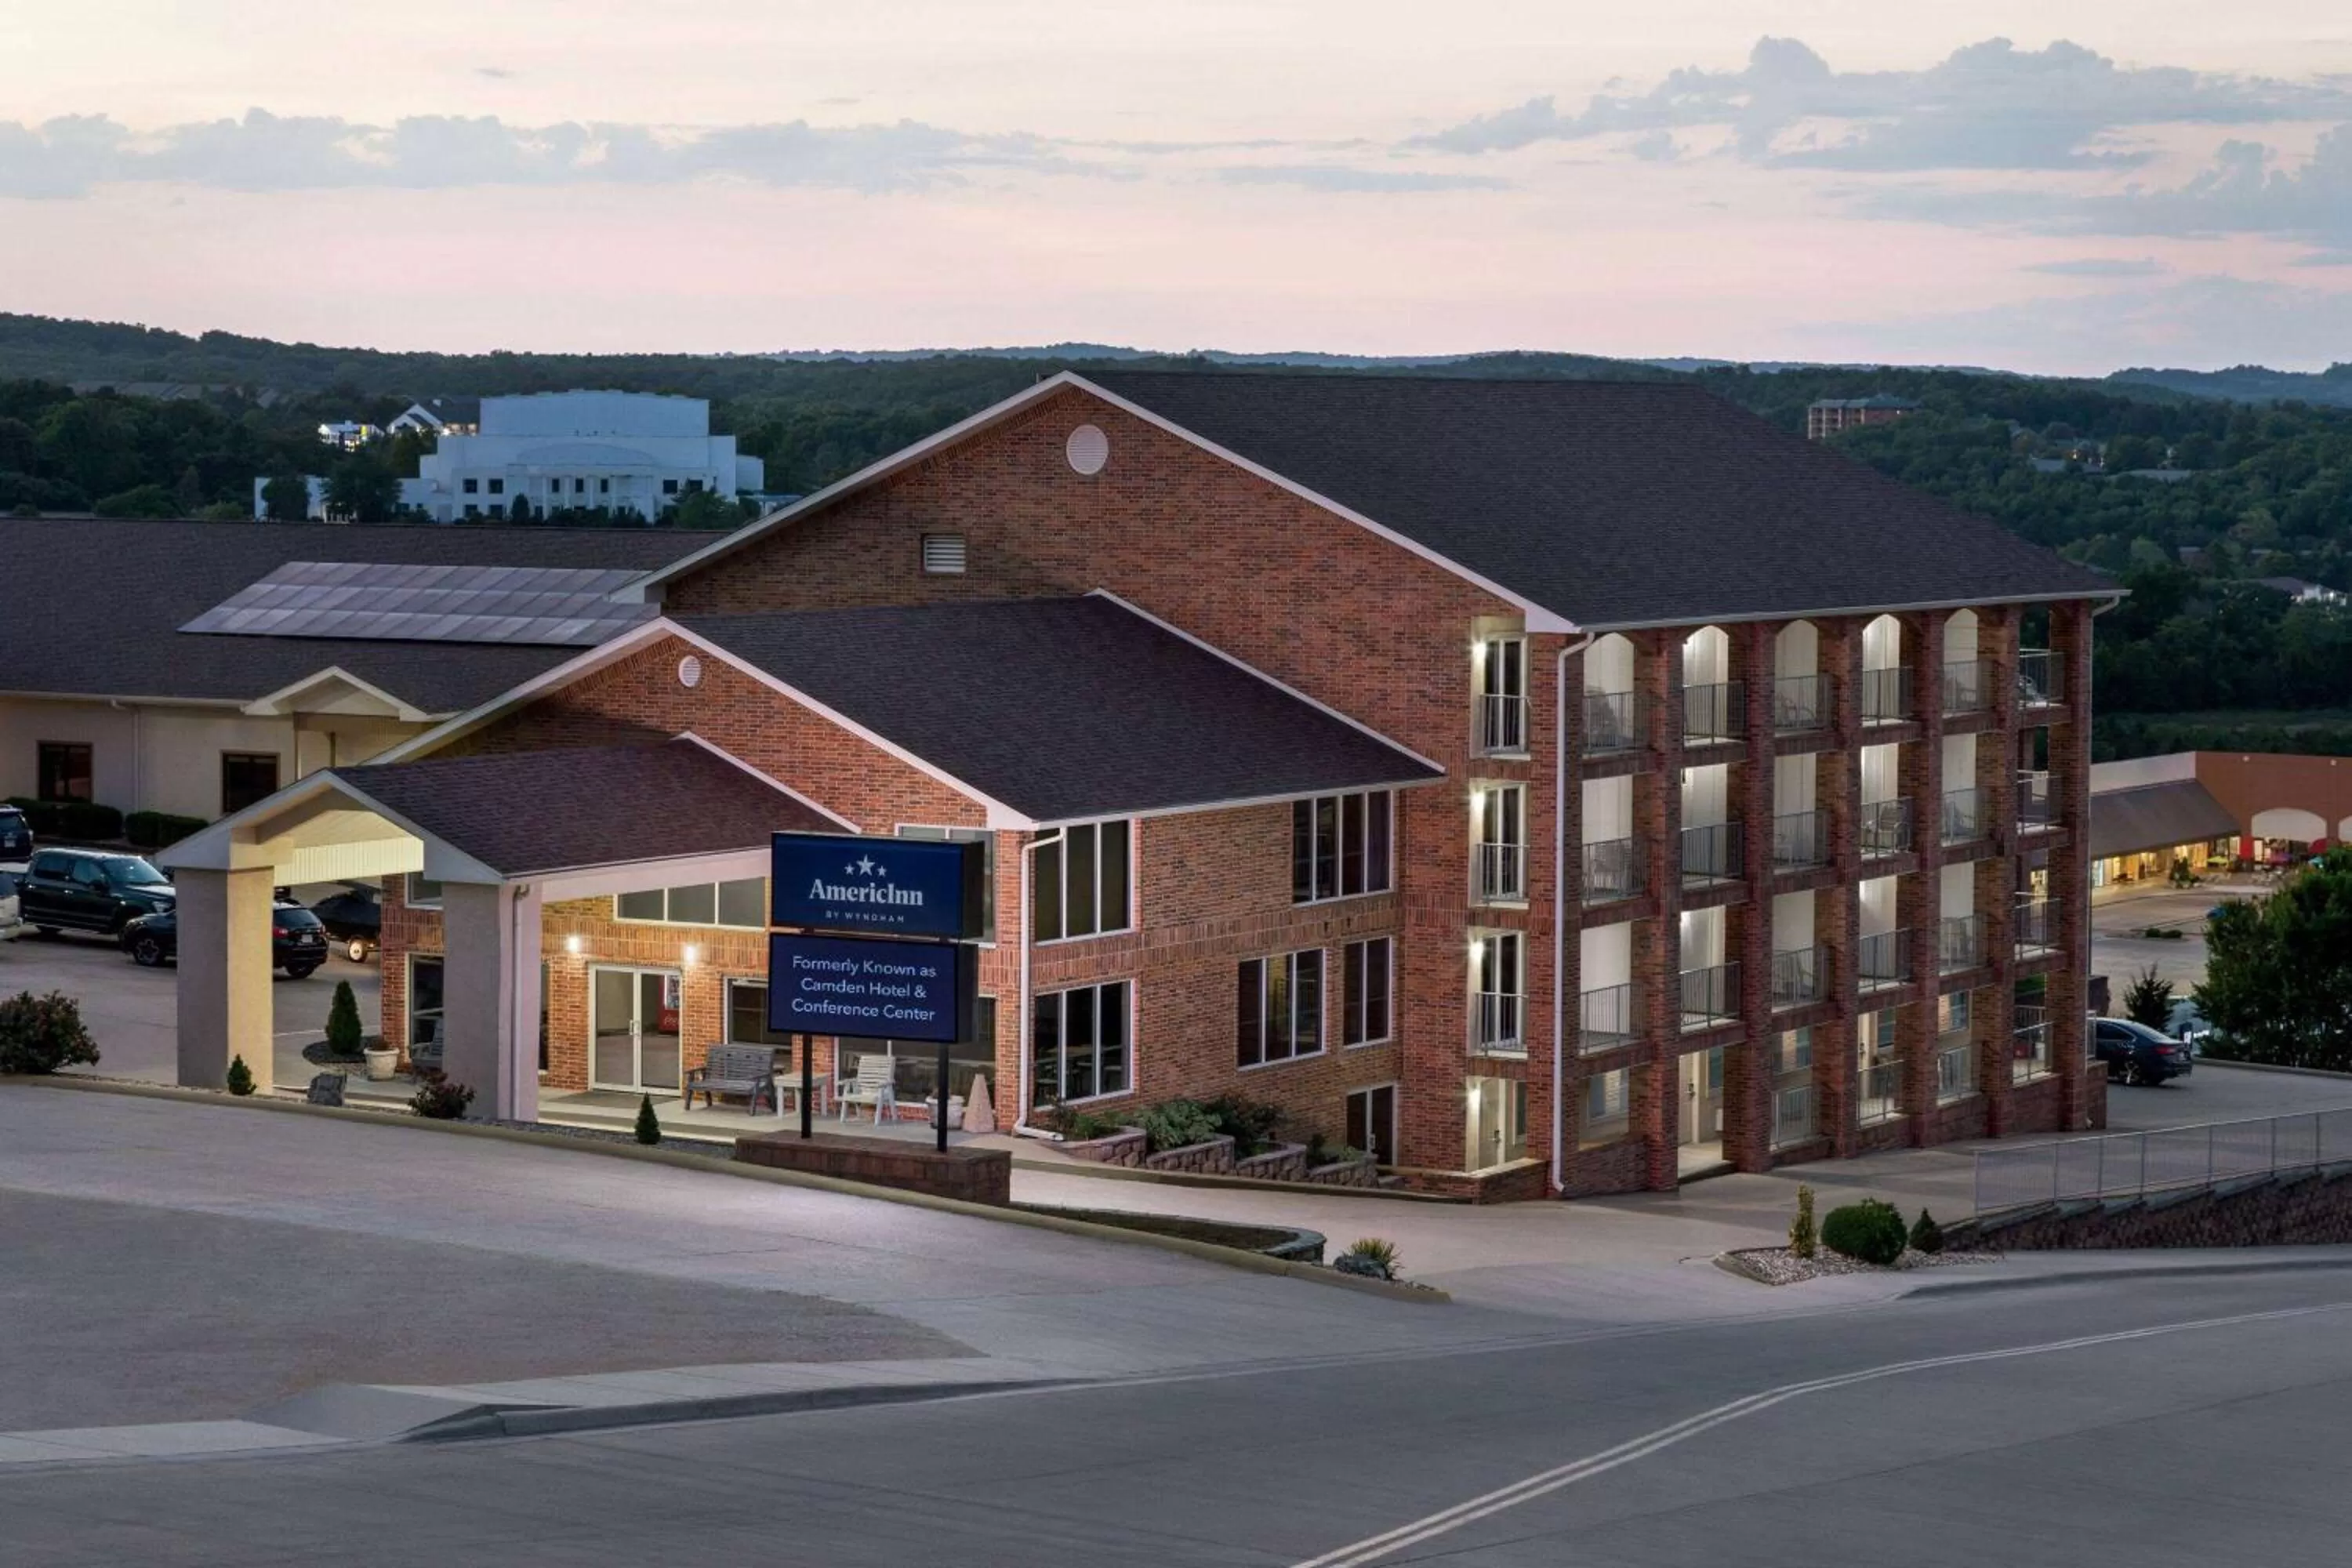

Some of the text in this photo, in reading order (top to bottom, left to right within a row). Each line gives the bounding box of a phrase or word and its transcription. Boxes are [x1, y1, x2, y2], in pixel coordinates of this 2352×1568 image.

[809, 878, 924, 906] AmericInn
[826, 910, 839, 919] BY
[793, 956, 937, 978] Formerly Known as
[800, 978, 927, 999] Camden Hotel &
[791, 998, 935, 1022] Conference Center
